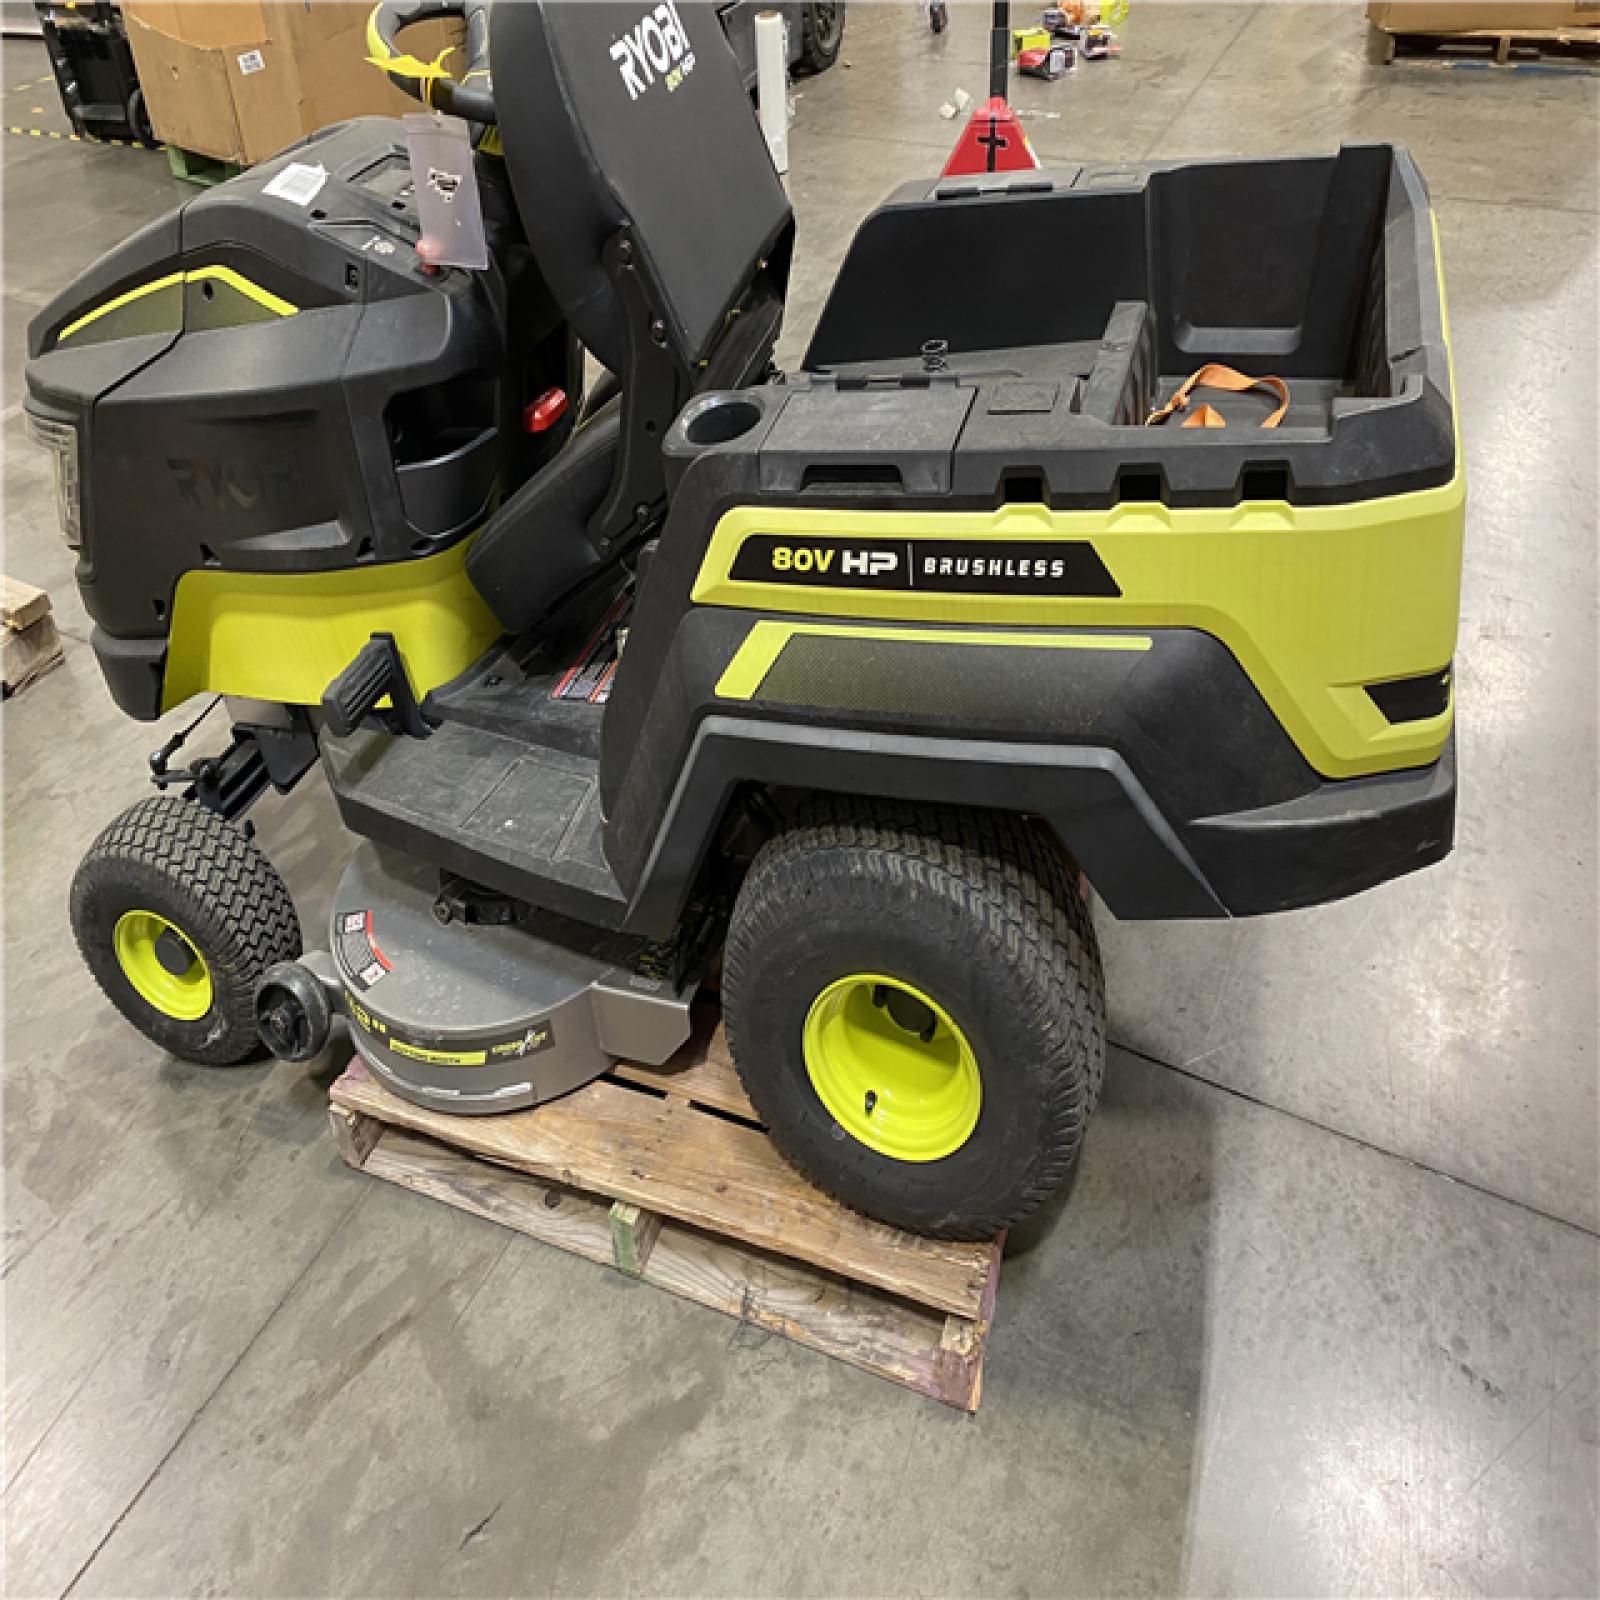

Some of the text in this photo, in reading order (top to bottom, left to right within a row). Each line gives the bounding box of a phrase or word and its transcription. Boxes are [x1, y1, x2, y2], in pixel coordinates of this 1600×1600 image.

[609, 0, 691, 101] RYOBI
[166, 455, 303, 512] RYO
[772, 546, 1066, 579] 80V HP BRUSHLESS
